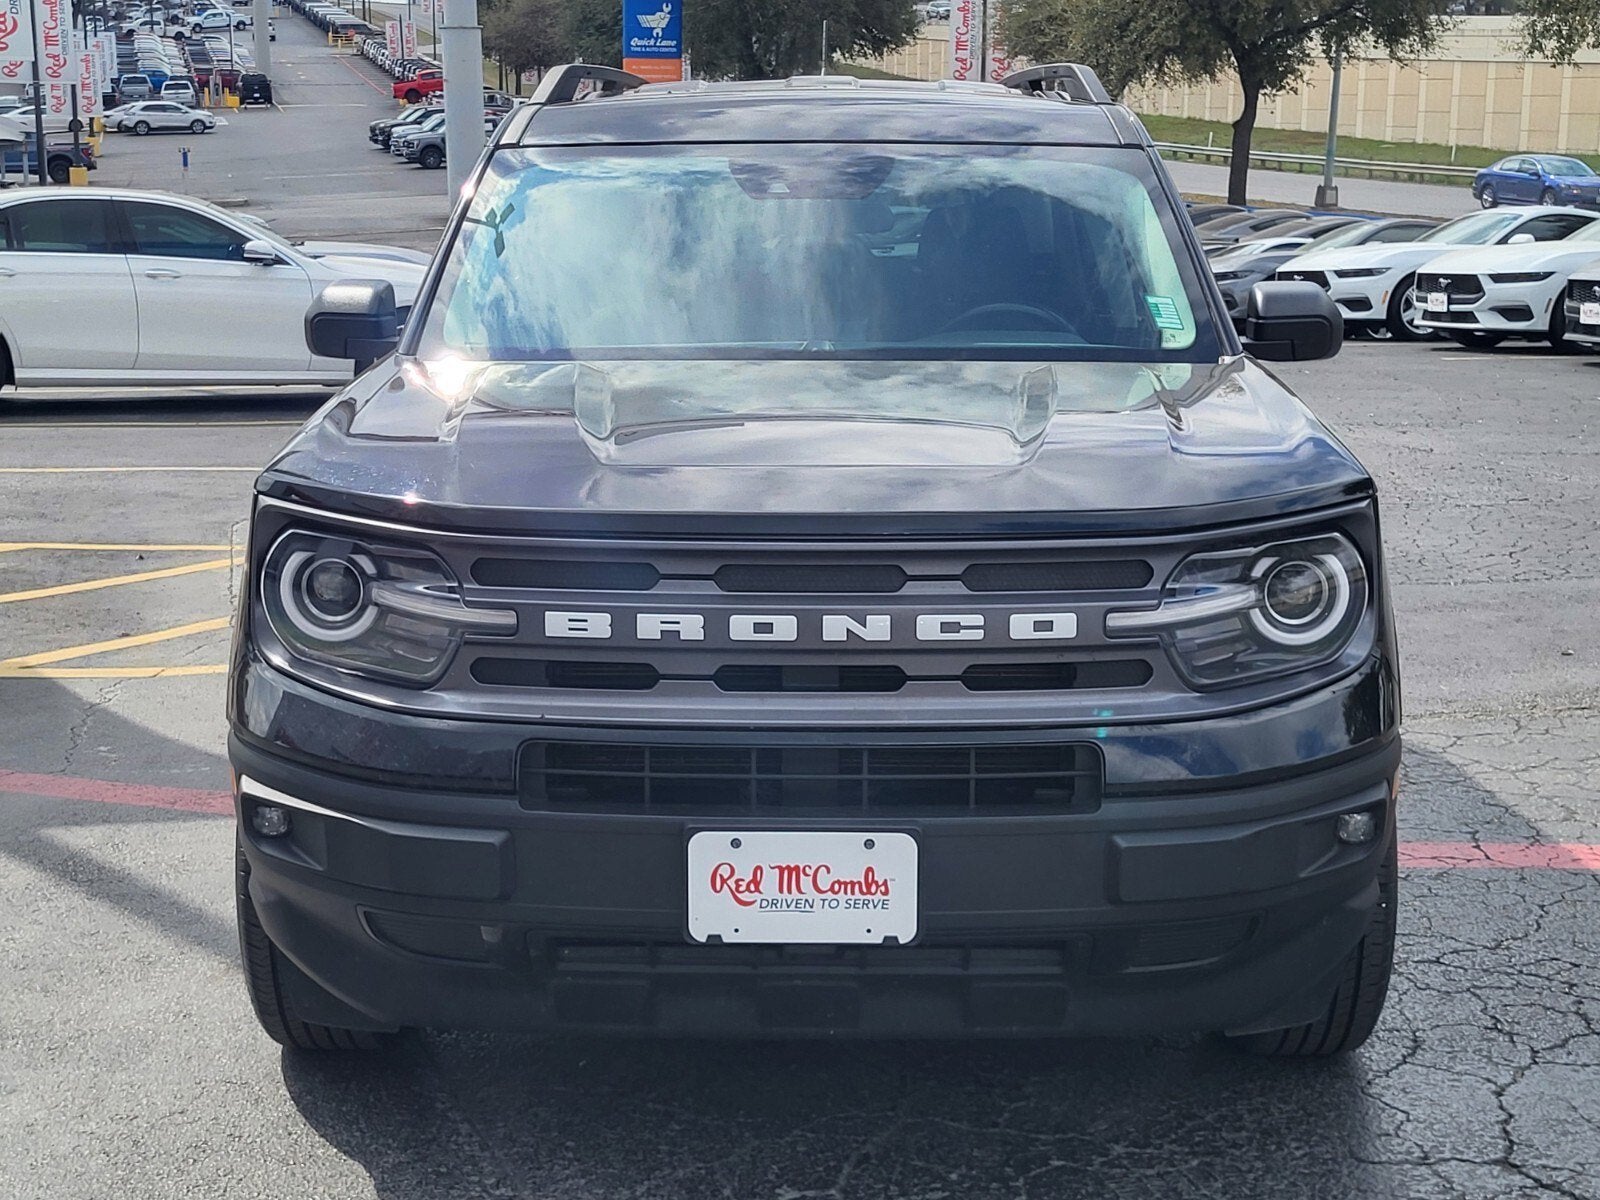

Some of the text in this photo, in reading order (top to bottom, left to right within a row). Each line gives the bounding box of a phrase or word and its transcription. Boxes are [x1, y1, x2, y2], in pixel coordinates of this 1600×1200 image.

[59, 16, 66, 27] TO
[630, 37, 677, 47] Quick Lane
[1, 60, 24, 78] Re
[44, 53, 67, 78] Red
[953, 57, 973, 80] Red
[50, 95, 67, 113] Red
[81, 96, 97, 113] Red
[544, 611, 1078, 642] BRONCO
[710, 862, 890, 907] Red McCombs
[758, 898, 890, 910] DRIVEN TO SERVE
